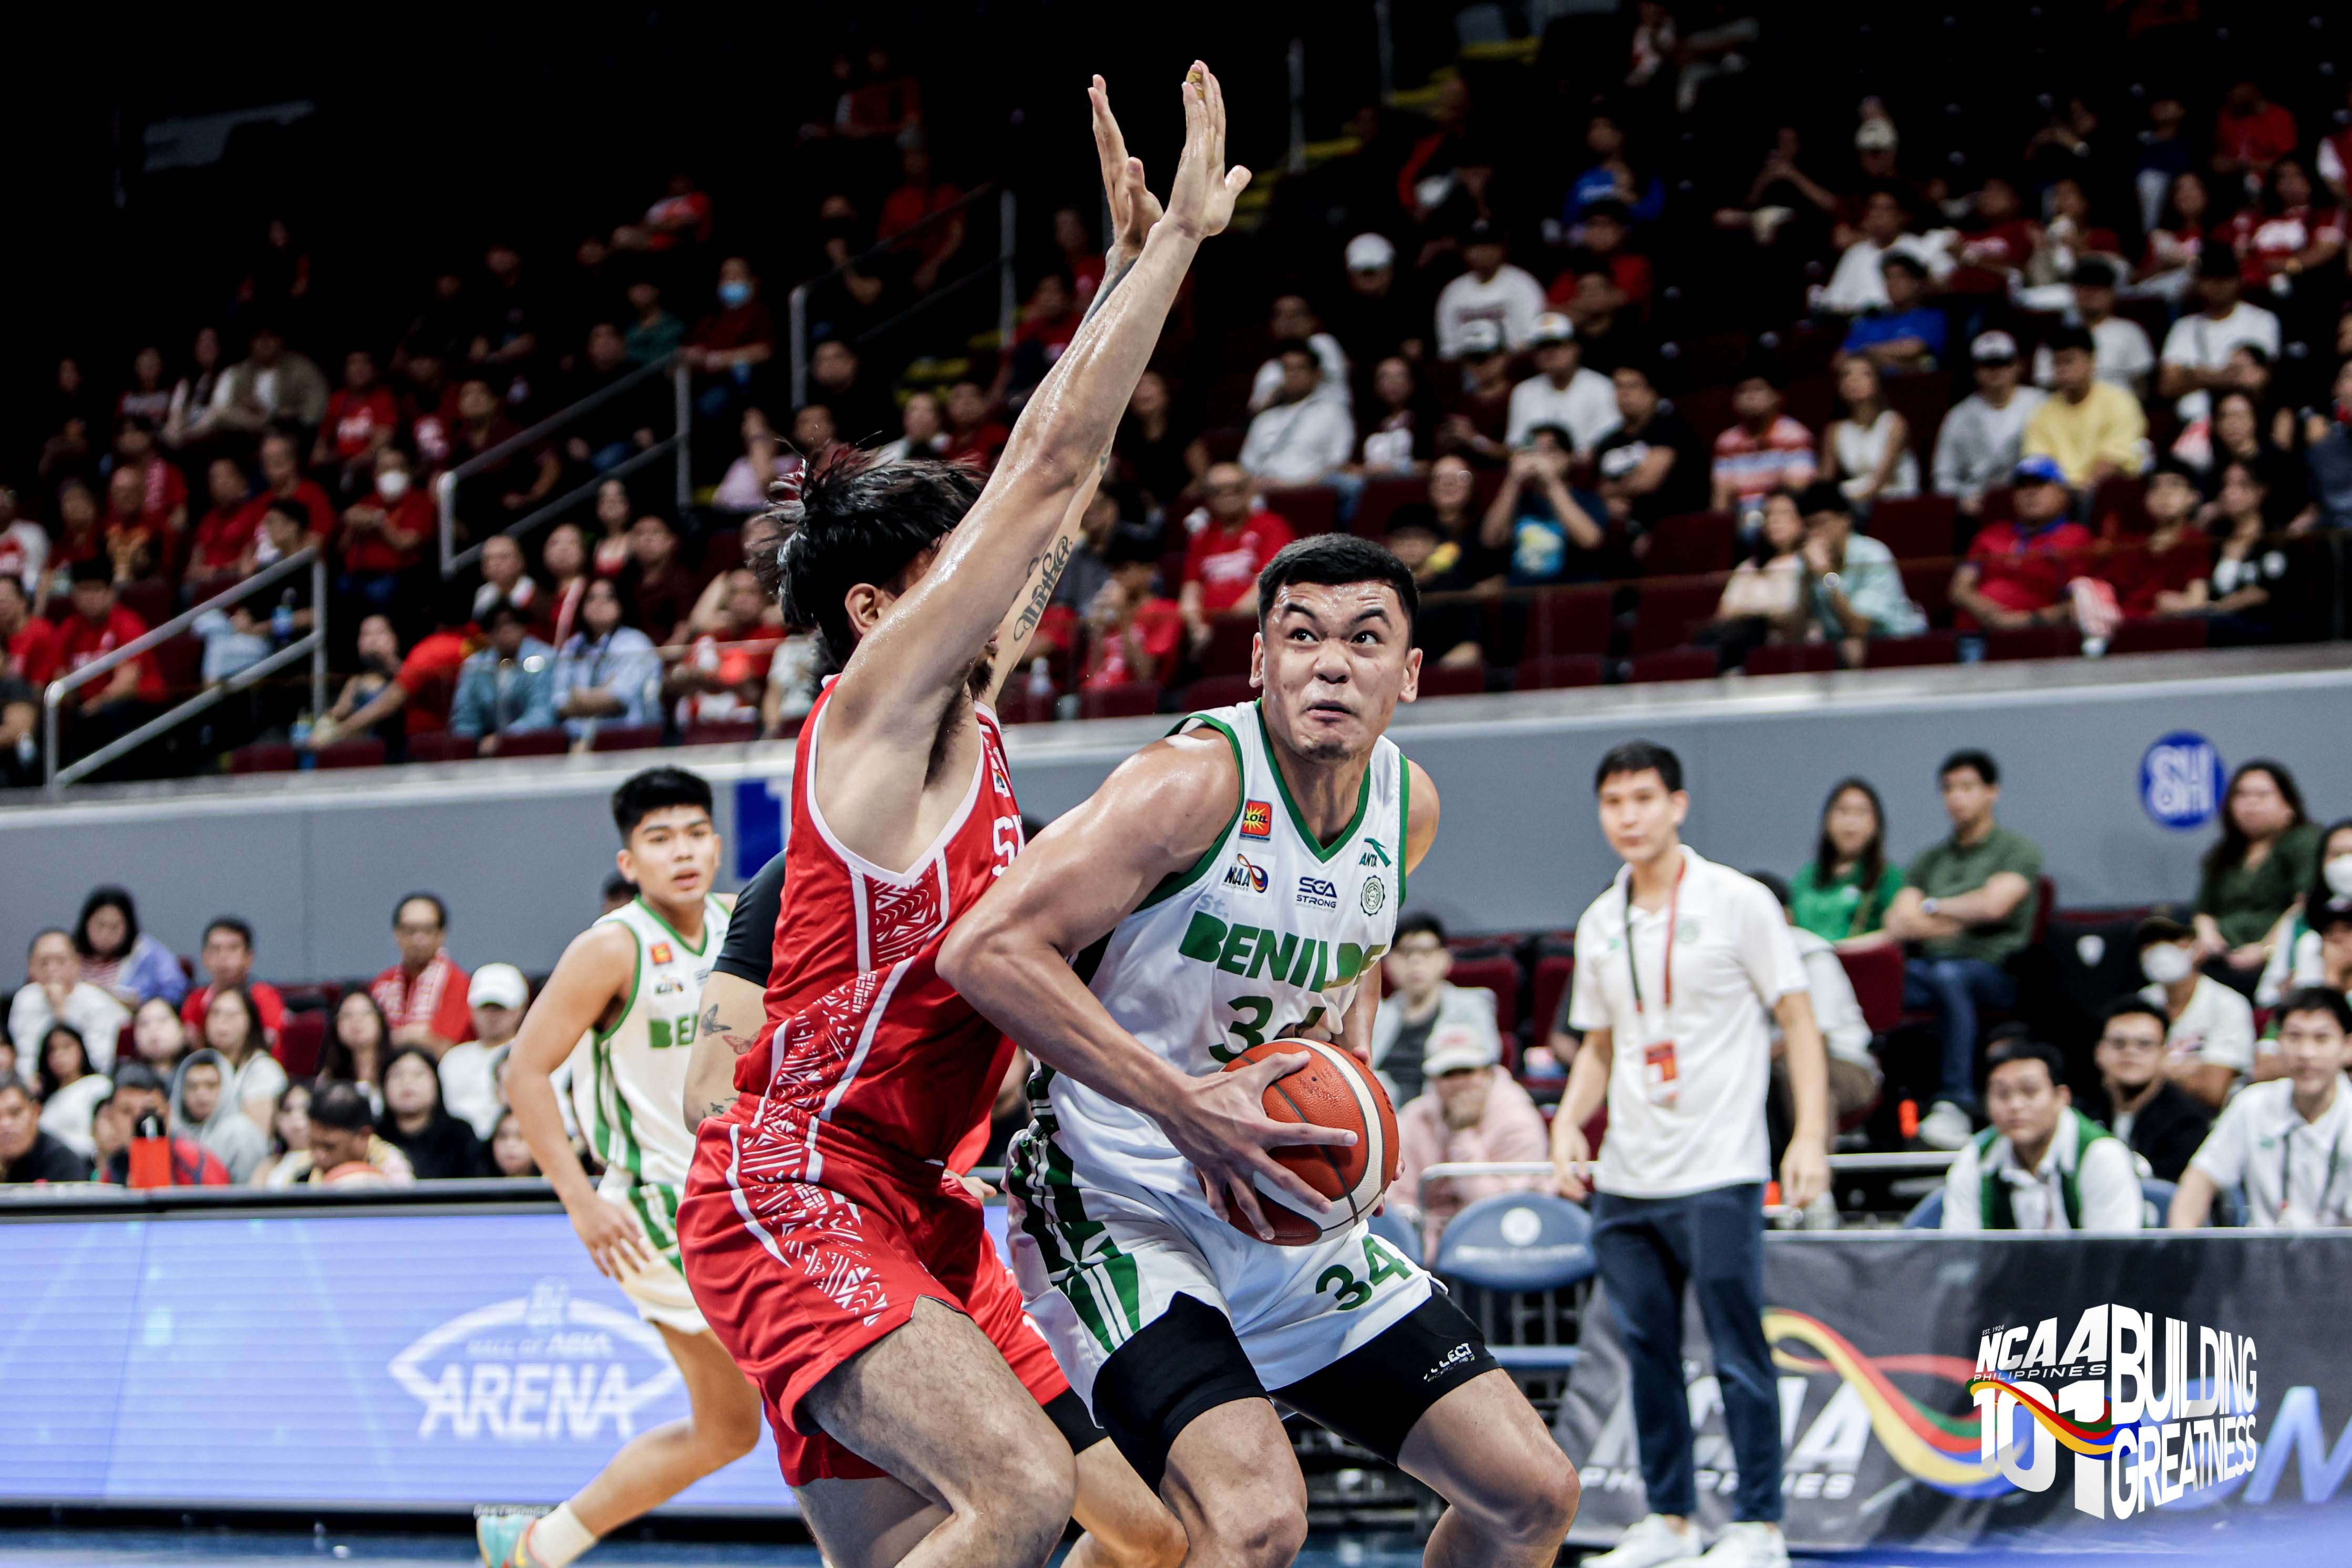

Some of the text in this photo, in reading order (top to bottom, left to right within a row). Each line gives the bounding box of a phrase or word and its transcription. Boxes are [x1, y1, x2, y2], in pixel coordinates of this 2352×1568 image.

[1359, 852, 1377, 867] ANTA
[1296, 894, 1337, 909] STRONG
[1298, 876, 1337, 899] SGA
[1178, 911, 1387, 993] BENILDE
[1315, 1233, 1412, 1311] 34
[418, 1363, 635, 1440] ARENA
